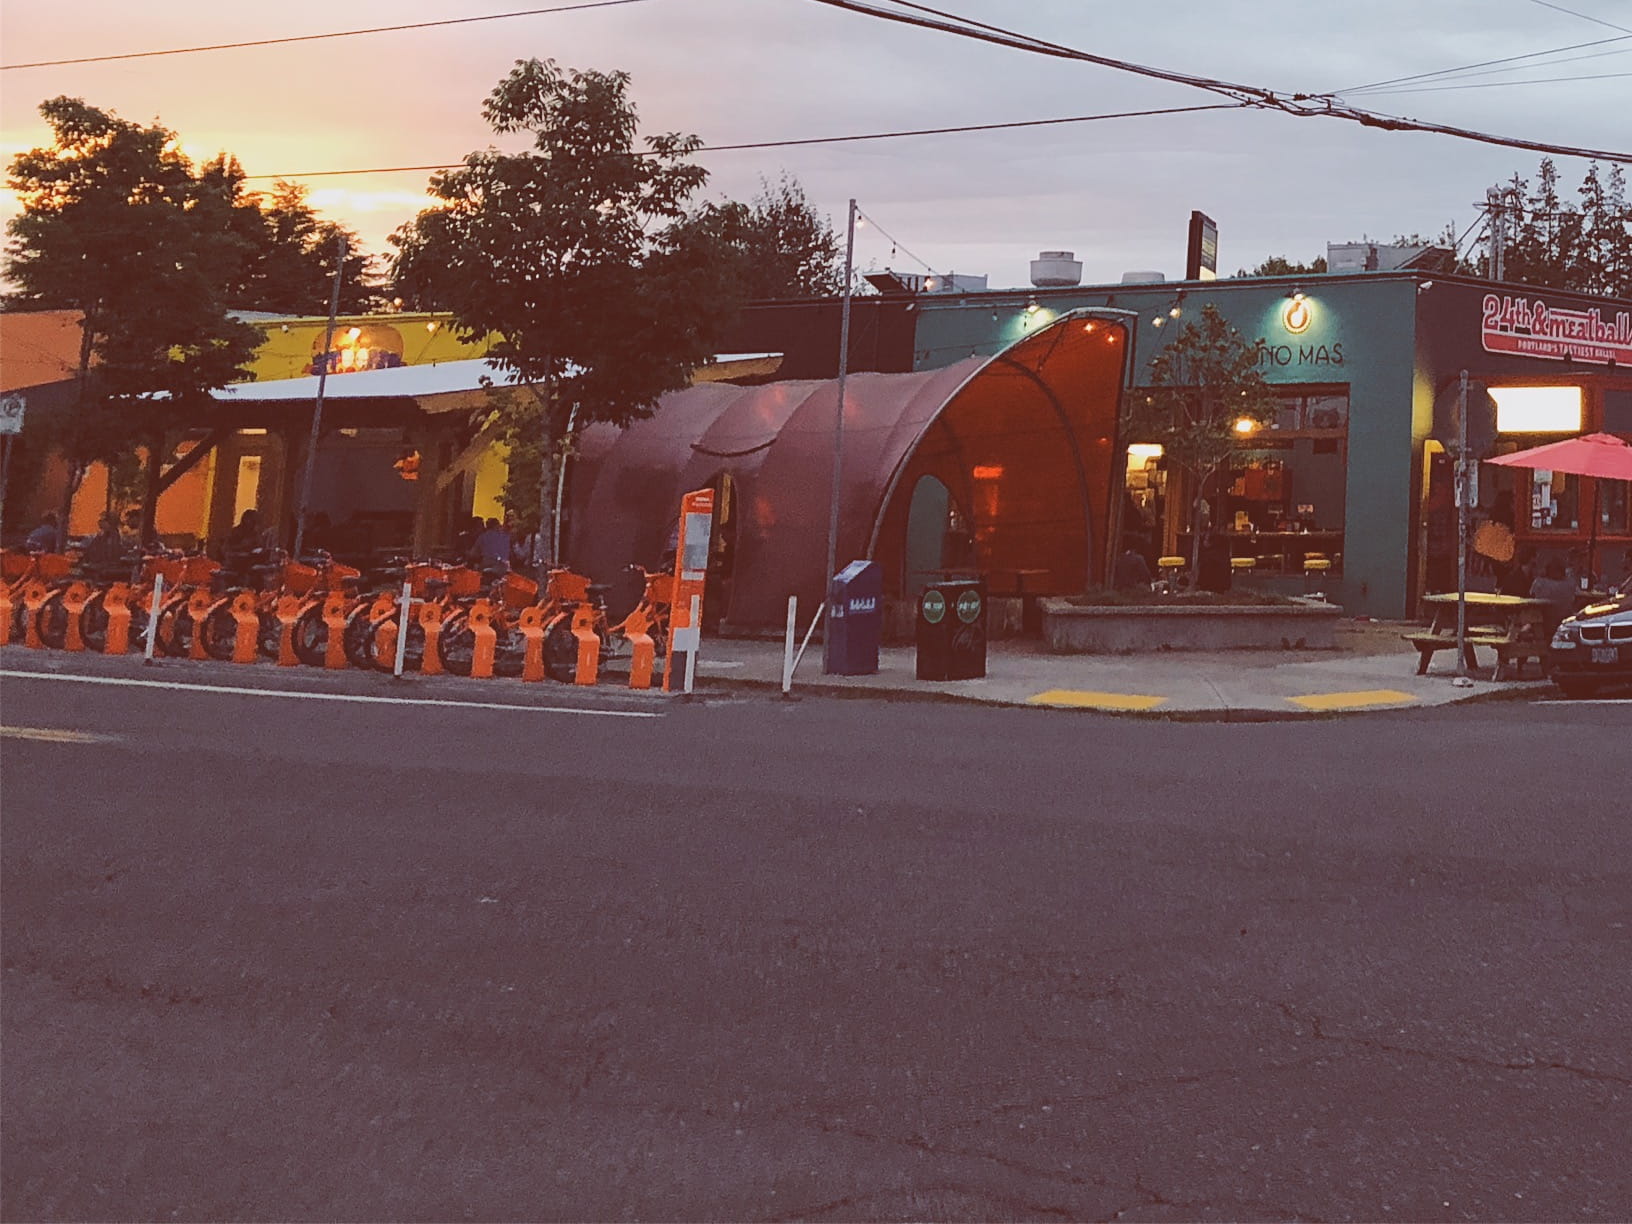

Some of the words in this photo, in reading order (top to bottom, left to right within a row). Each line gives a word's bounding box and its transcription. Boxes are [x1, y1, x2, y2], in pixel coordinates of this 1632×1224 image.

[1483, 294, 1531, 332] 24th
[1531, 300, 1549, 336] &
[1298, 342, 1344, 366] MAS
[1517, 339, 1559, 354] PORTLAND'S
[1559, 344, 1594, 358] TASTIEST
